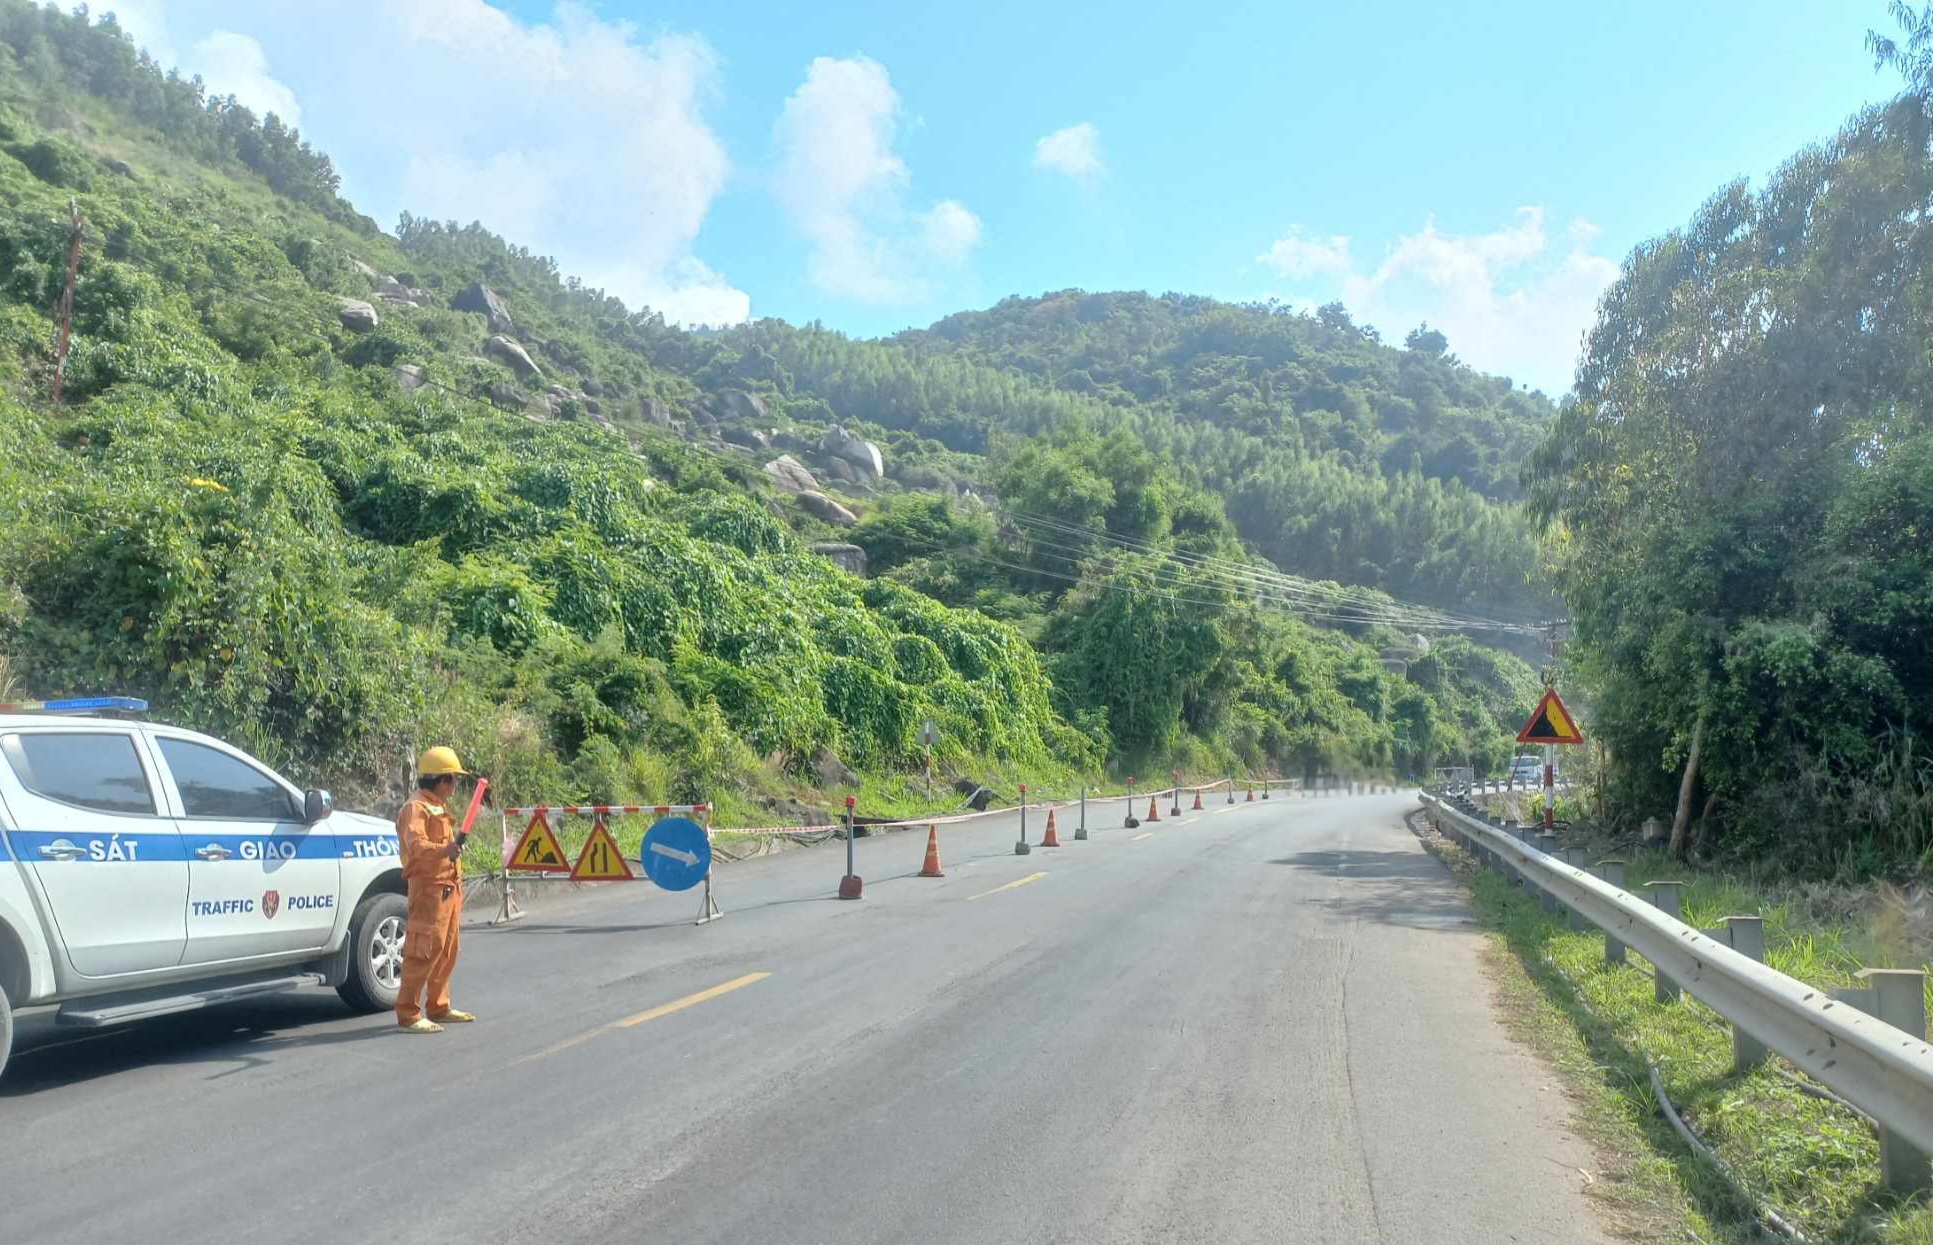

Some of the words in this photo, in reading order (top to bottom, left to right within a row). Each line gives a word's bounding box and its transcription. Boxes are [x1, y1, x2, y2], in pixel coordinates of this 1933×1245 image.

[89, 833, 139, 861] SÁT
[239, 840, 297, 860] GIAO
[192, 899, 254, 916] TRAFFIC
[287, 895, 334, 910] POLICE
